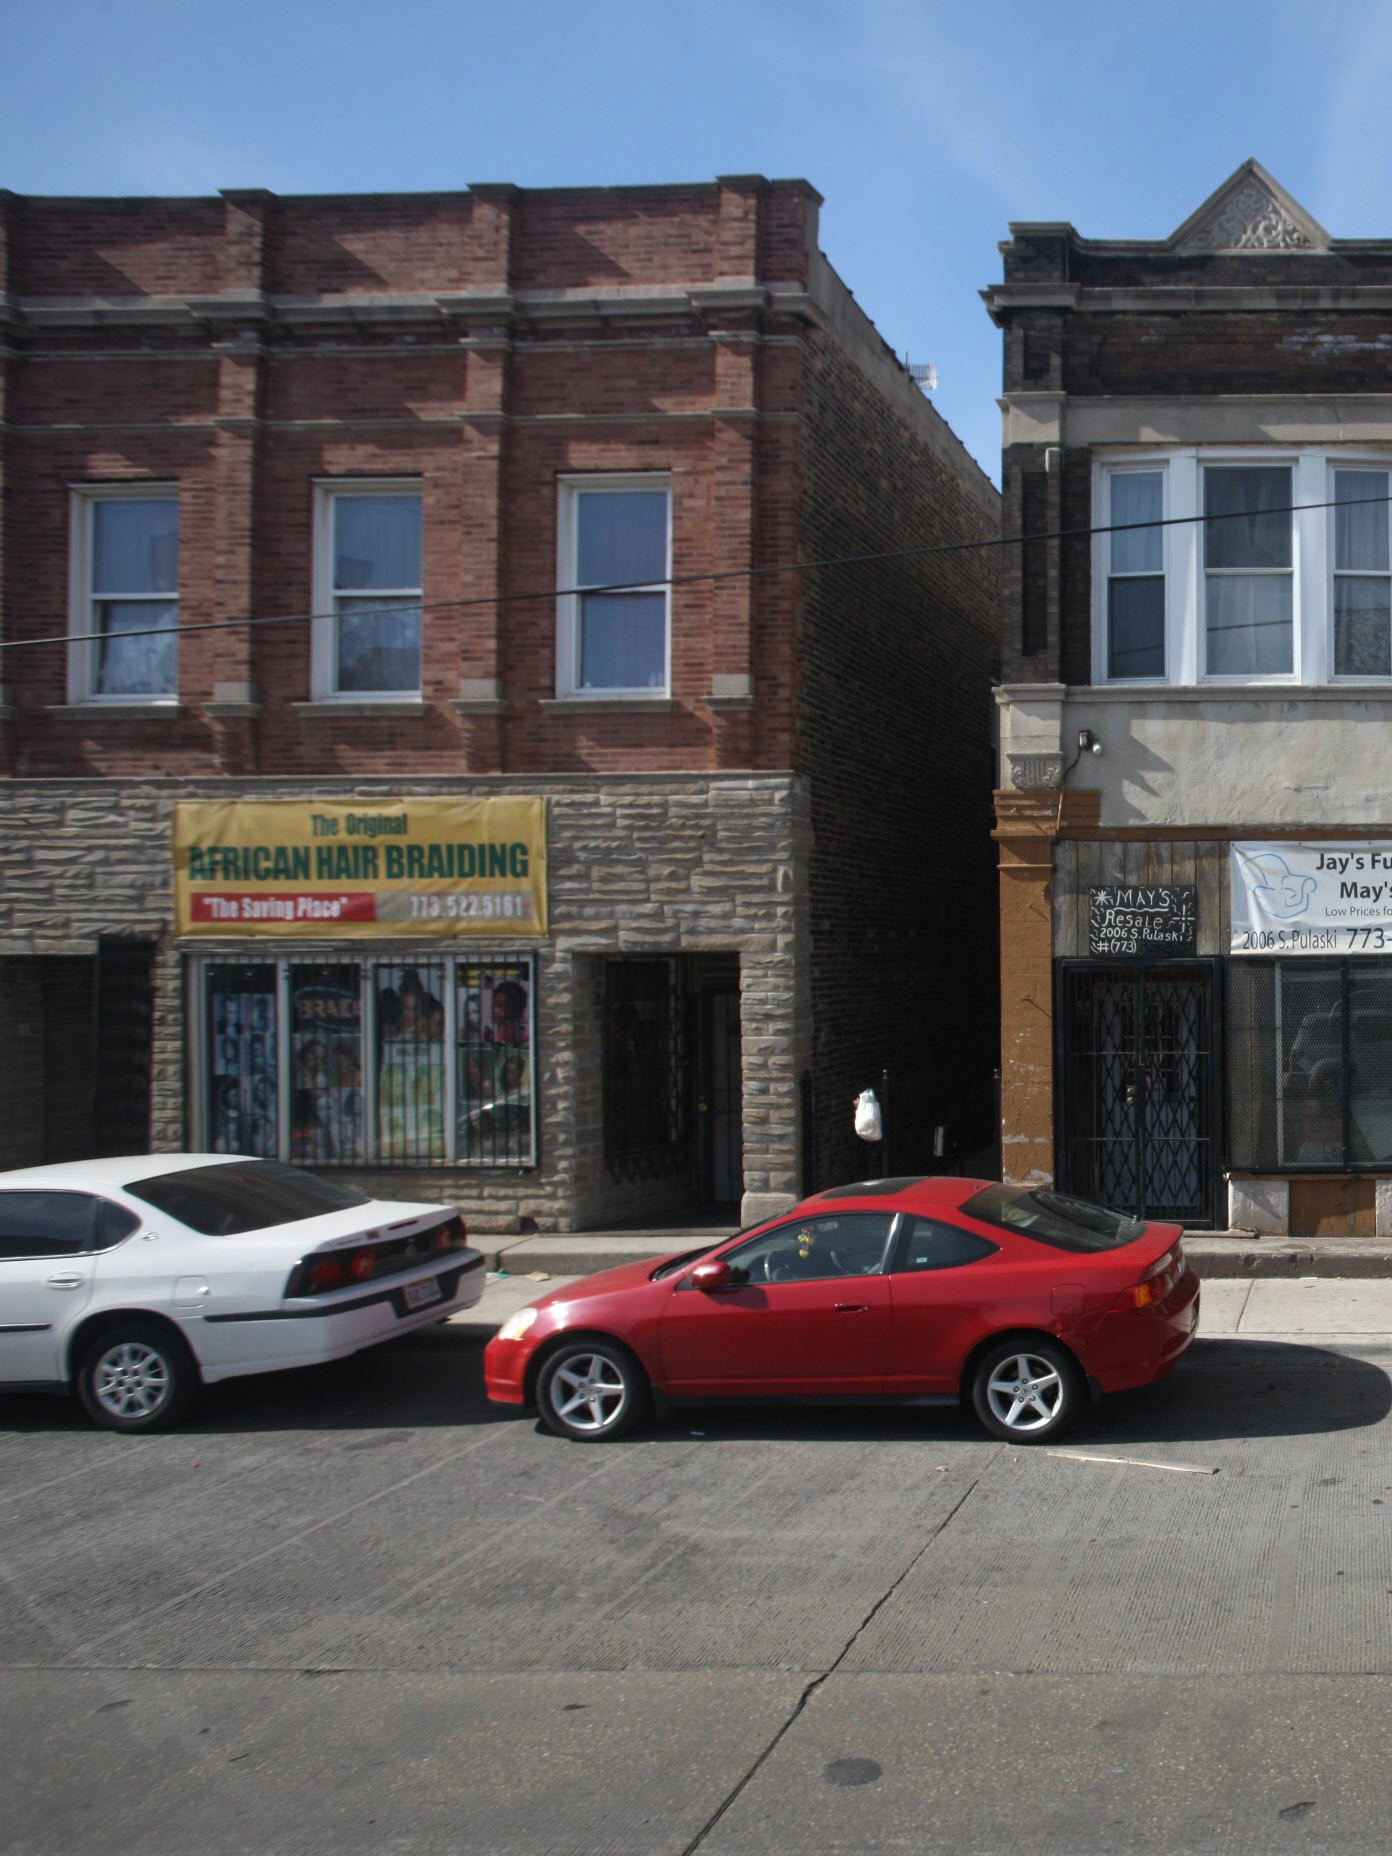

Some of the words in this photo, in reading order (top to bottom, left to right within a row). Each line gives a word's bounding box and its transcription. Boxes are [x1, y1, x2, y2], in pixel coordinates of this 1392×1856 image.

[311, 813, 338, 836] The
[346, 813, 408, 838] Original
[188, 845, 311, 881] AFRICAN
[316, 845, 378, 880] HAIR
[384, 842, 529, 879] BRAIDING
[1316, 852, 1365, 874] Jay's
[203, 897, 240, 918] "The
[241, 896, 295, 920] Saving
[297, 896, 349, 918] Place"
[1116, 888, 1171, 907] MAY'S
[1324, 906, 1347, 917] Low
[1350, 906, 1380, 917] Prices
[1100, 927, 1129, 938] 2006
[1142, 927, 1183, 942] Pulaski
[1242, 930, 1275, 951] 2006
[1291, 928, 1338, 950] Pulaski
